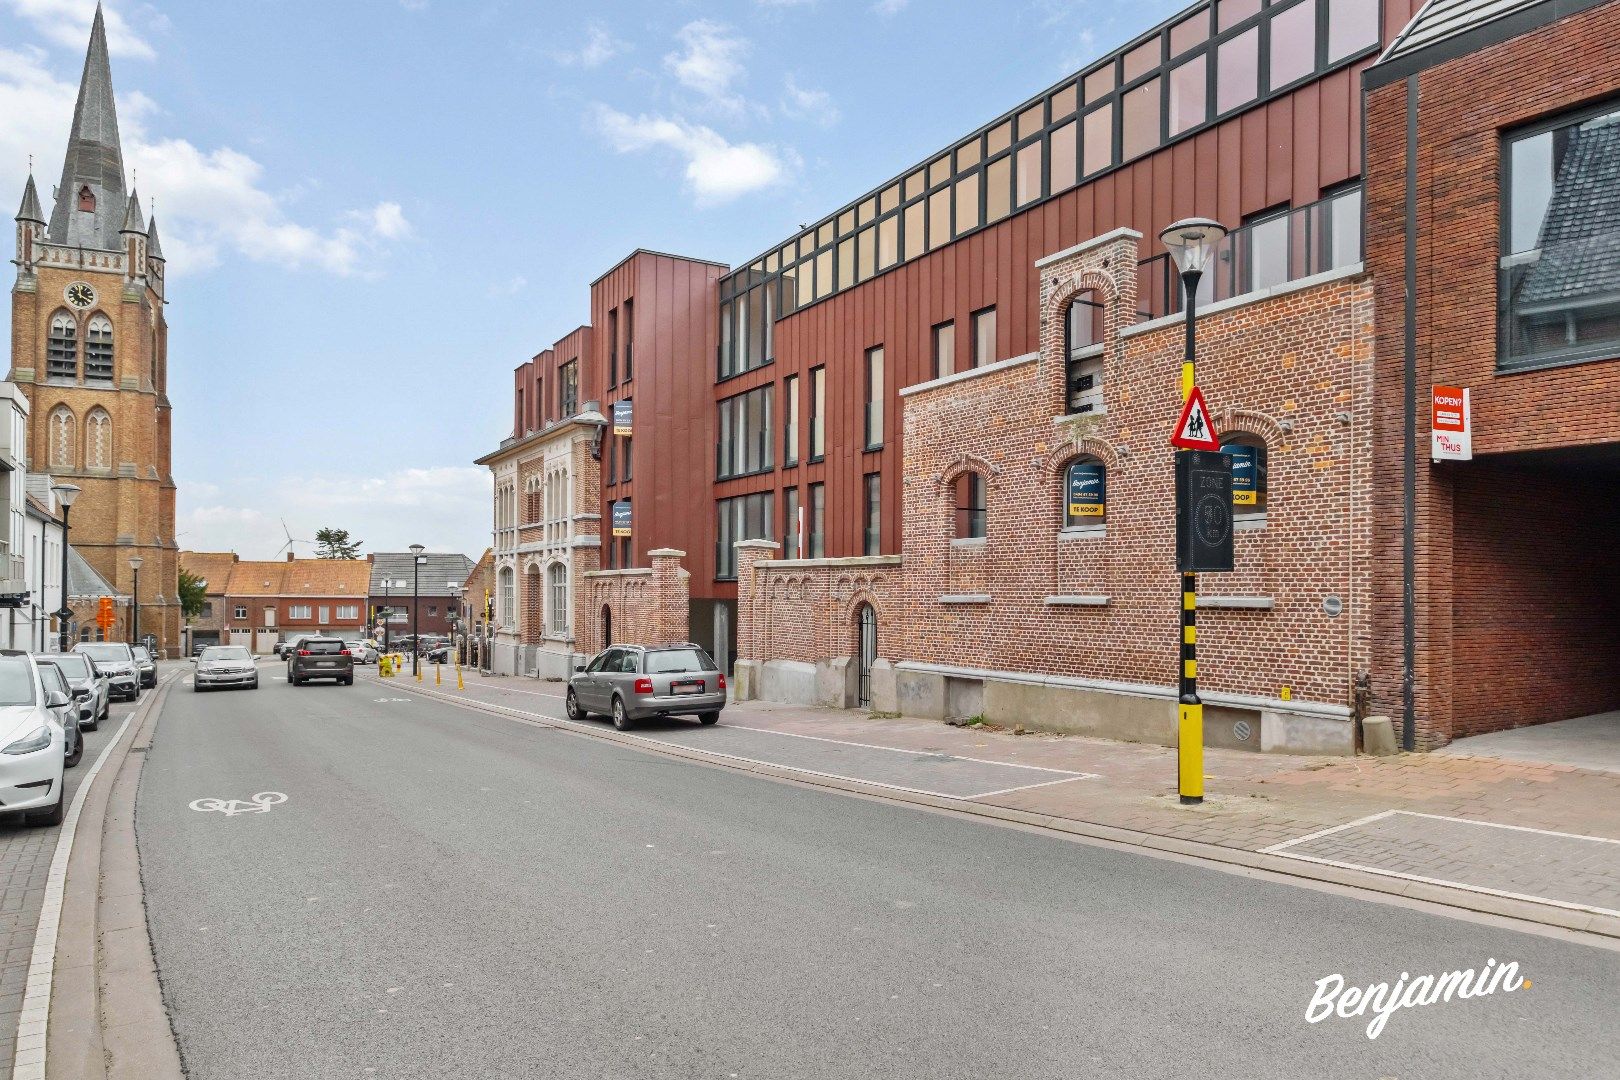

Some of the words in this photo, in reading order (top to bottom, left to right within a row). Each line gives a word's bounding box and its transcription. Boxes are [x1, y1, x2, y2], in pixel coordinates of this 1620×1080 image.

[1434, 395, 1462, 407] KOPEN?
[1436, 435, 1449, 443] MIN
[1441, 443, 1461, 452] THUS
[1200, 476, 1224, 489] ZONE
